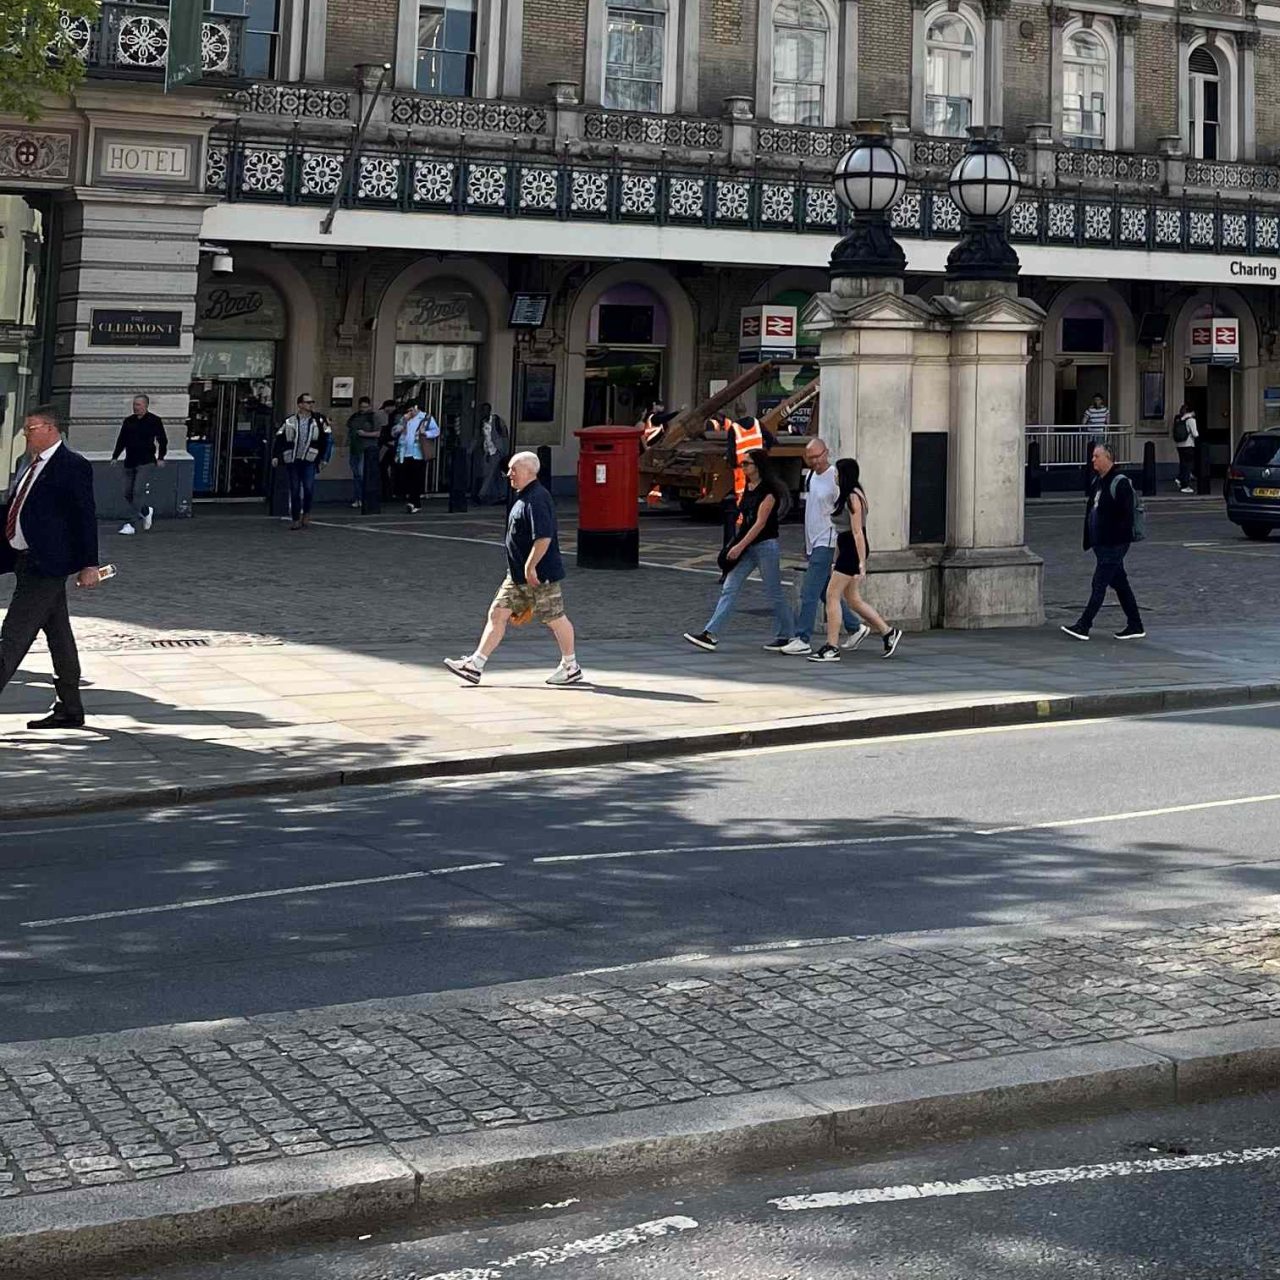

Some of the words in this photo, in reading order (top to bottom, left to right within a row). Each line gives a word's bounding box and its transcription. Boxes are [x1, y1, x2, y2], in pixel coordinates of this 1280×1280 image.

[110, 147, 182, 172] HOTEL
[1230, 261, 1277, 280] Charing
[200, 288, 263, 319] Boots
[99, 322, 176, 334] CLERMONT
